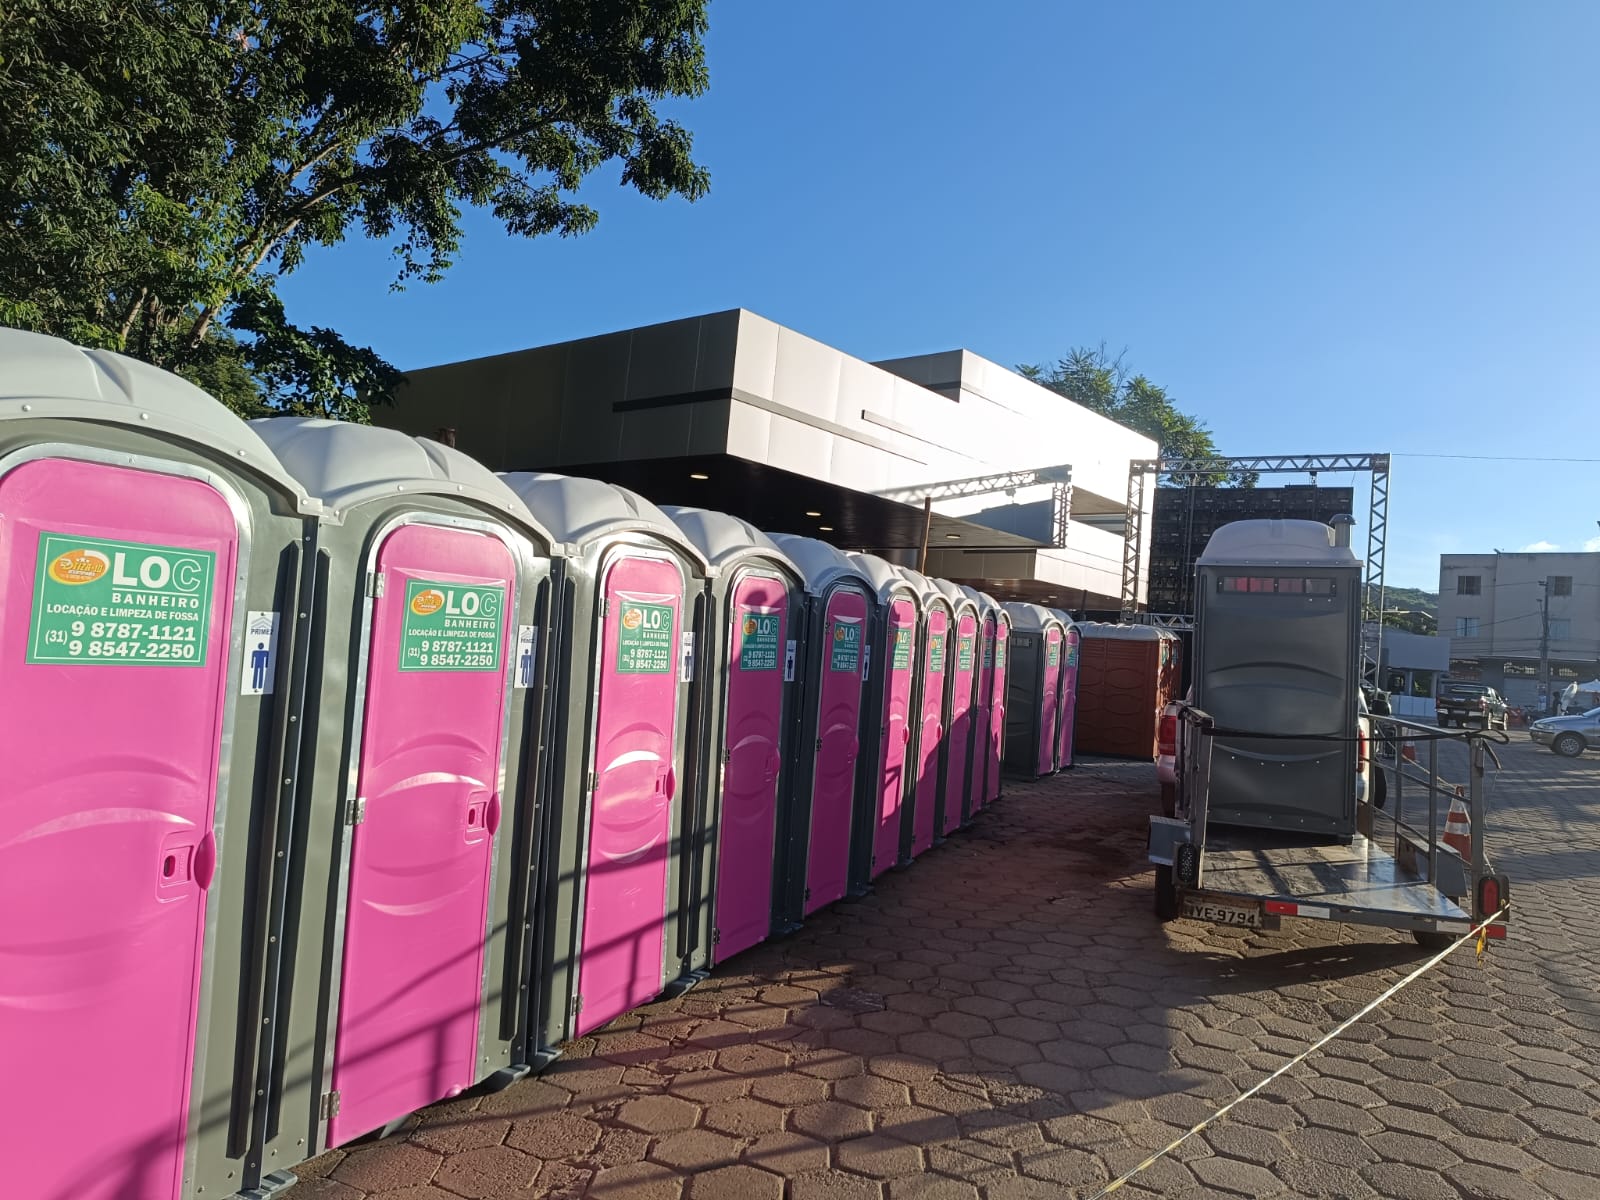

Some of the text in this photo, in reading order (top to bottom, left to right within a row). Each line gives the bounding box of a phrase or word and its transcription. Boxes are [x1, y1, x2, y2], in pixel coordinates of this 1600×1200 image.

[112, 552, 201, 592] LOC
[112, 593, 199, 608] BANHEIRO
[445, 590, 497, 617] LOC
[47, 603, 199, 621] LOCAÇÃO E LIMPEZA DE FOSSA
[643, 609, 669, 630] LOC
[71, 621, 196, 641] 9 8787-1121
[444, 619, 496, 629] BANHEIRO
[757, 619, 777, 635] LOC
[45, 630, 68, 646] (31)
[408, 628, 437, 638] LOCAÇÃO
[443, 630, 468, 638] LIMPEZA
[477, 631, 495, 639] FOSSA
[69, 640, 195, 659] 9 8547-2250
[408, 648, 420, 658] (31)
[421, 641, 494, 653] 9 8787-1121
[630, 649, 667, 658] 9 8787-1121
[420, 655, 493, 666] 9 8547-2250
[629, 659, 668, 669] 9 8547-2250
